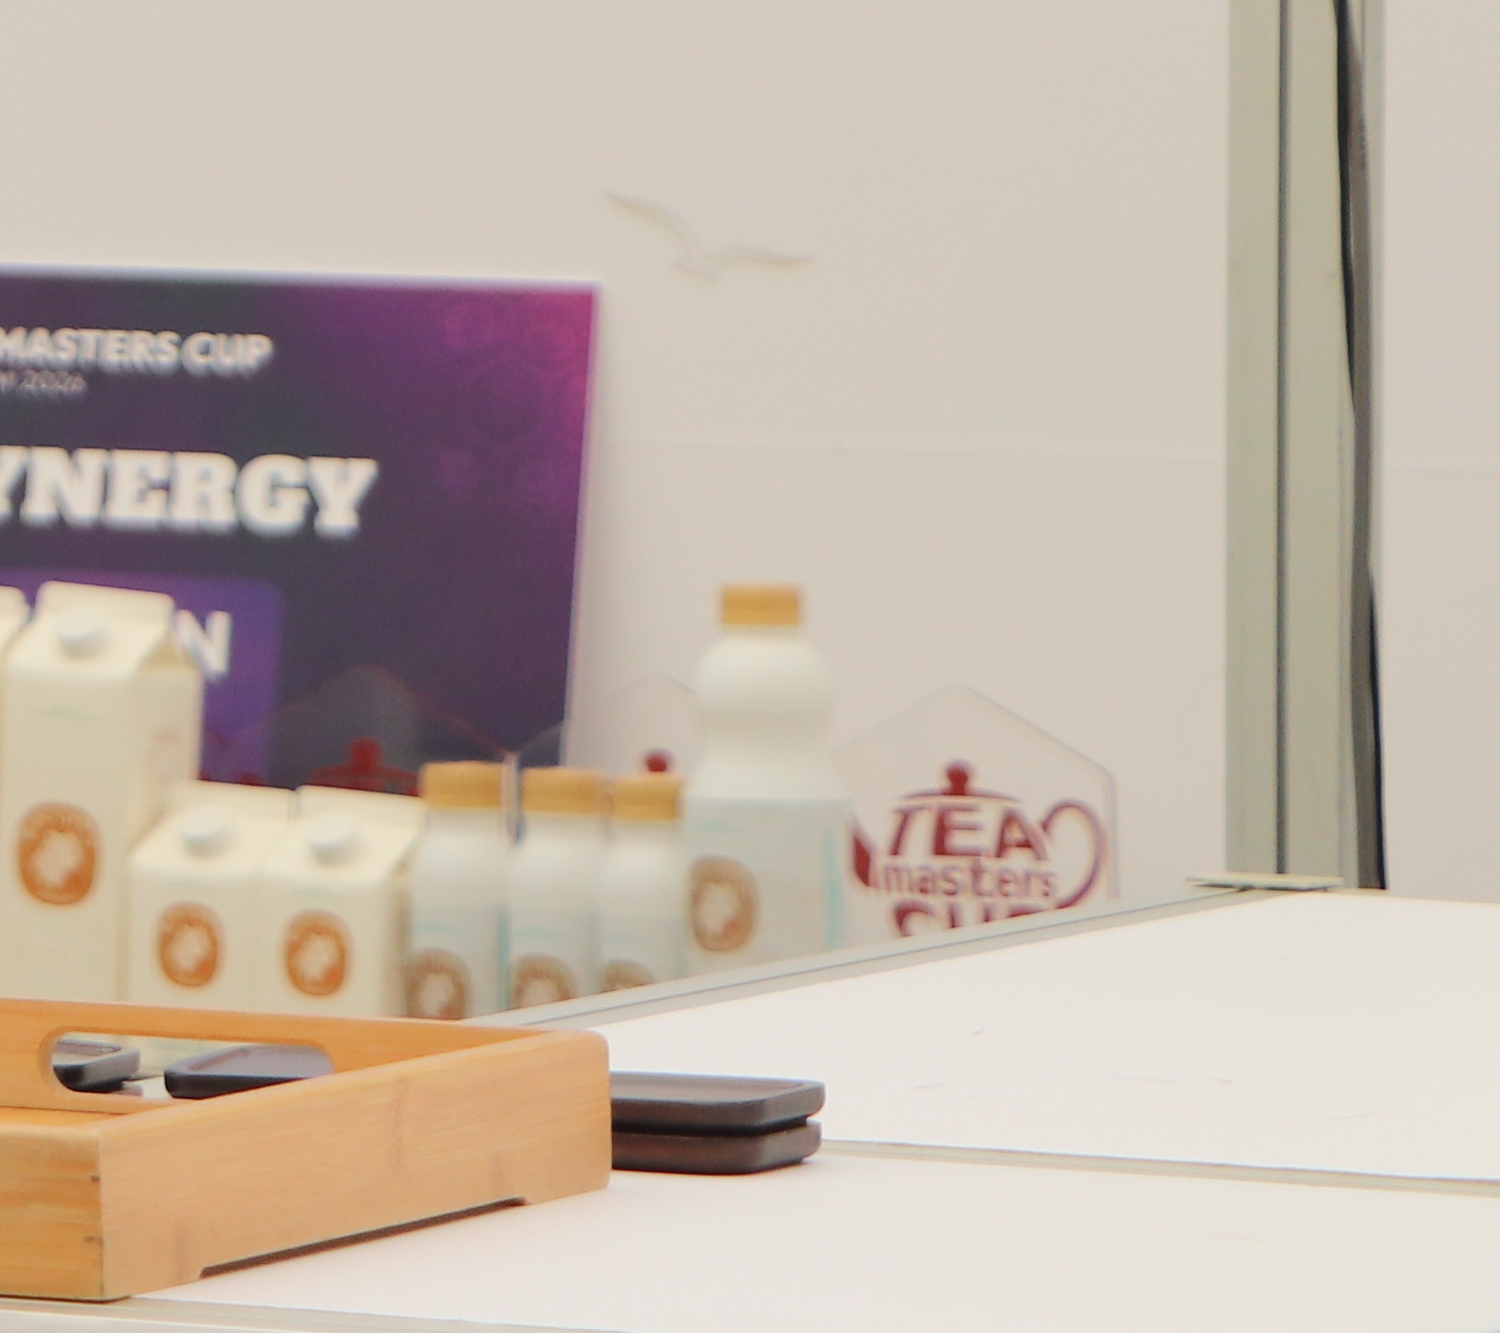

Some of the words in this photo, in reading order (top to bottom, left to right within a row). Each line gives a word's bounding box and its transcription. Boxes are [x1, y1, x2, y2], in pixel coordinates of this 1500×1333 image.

[182, 331, 275, 378] CUP
[888, 802, 1047, 861] TEA
[882, 857, 1058, 897] masters
